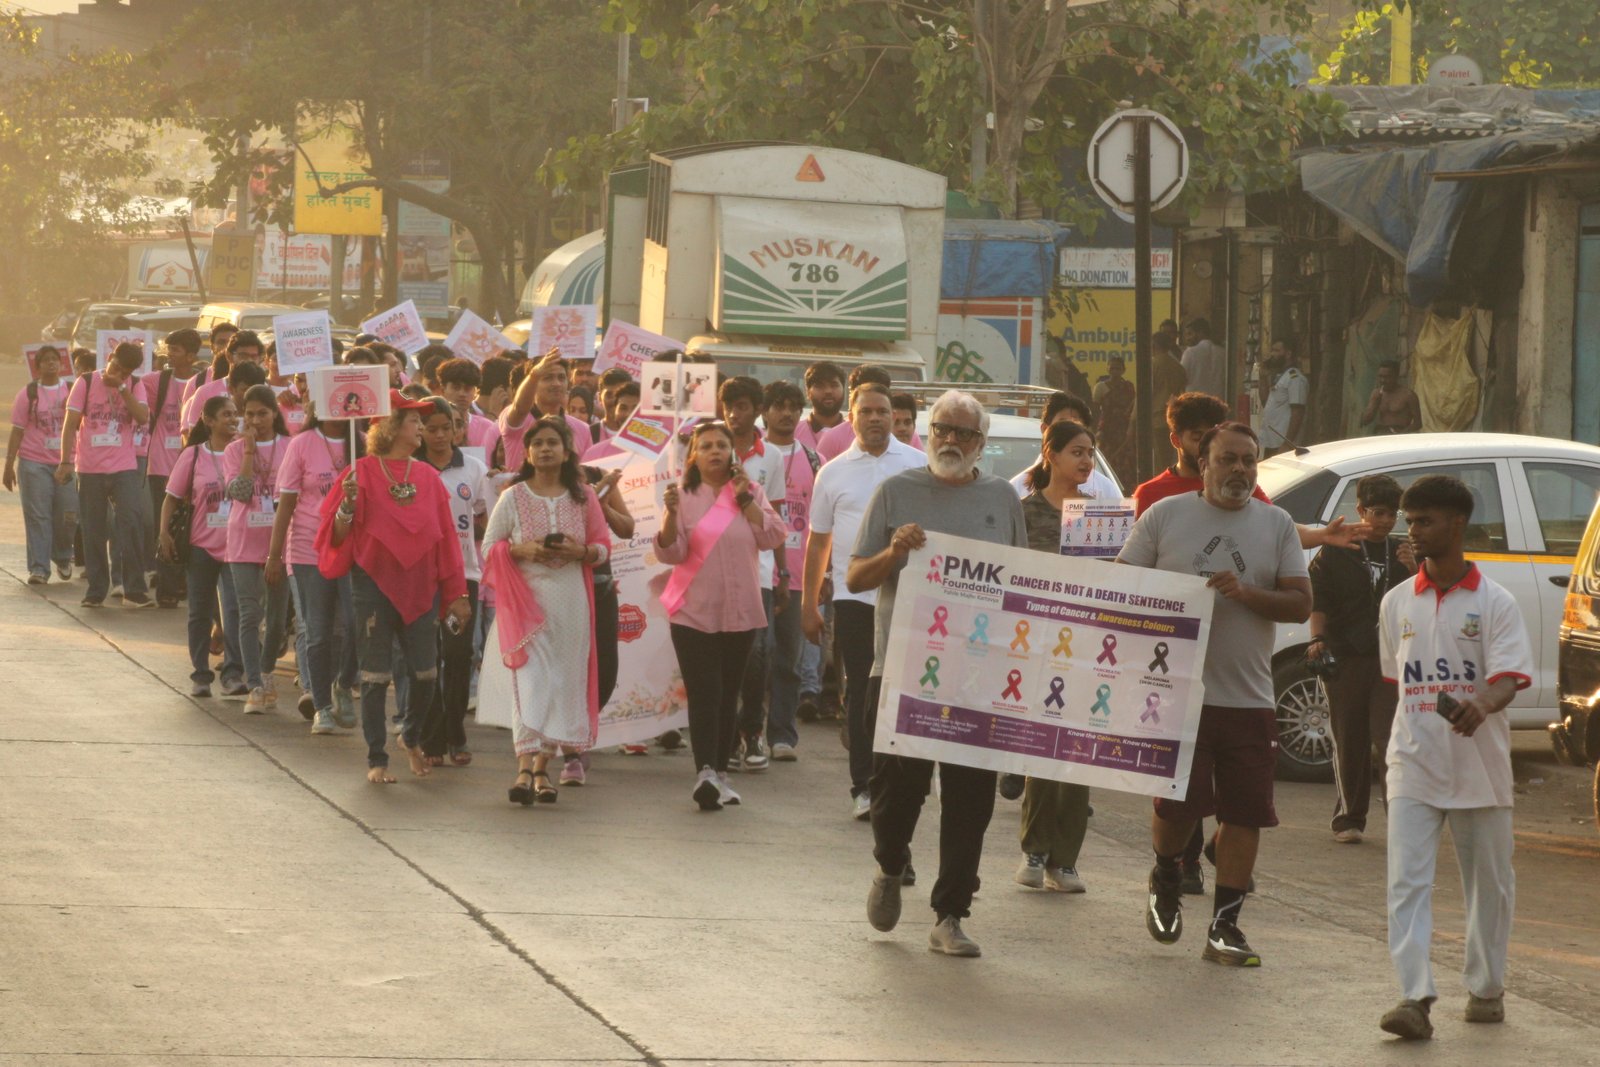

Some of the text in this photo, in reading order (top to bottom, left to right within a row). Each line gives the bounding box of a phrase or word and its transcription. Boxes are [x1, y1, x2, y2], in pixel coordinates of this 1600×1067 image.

[215, 256, 250, 271] PUC
[749, 238, 880, 274] MUSKAN
[787, 262, 840, 283] 786
[1065, 270, 1128, 283] NO DONATION
[282, 326, 324, 339] AWARENESS
[294, 346, 319, 357] CURE.
[624, 470, 671, 488] SPECIAL
[942, 554, 1005, 586] PMK
[942, 576, 1003, 596] Foundation
[1009, 574, 1185, 614] CANCER IS NOT A DEATH SENTECNCE
[1025, 600, 1176, 633] Types of Cancer & Awareness Colours
[1404, 658, 1476, 683] N.S.S
[1406, 685, 1425, 696] NOT
[1151, 743, 1172, 752] Cause
